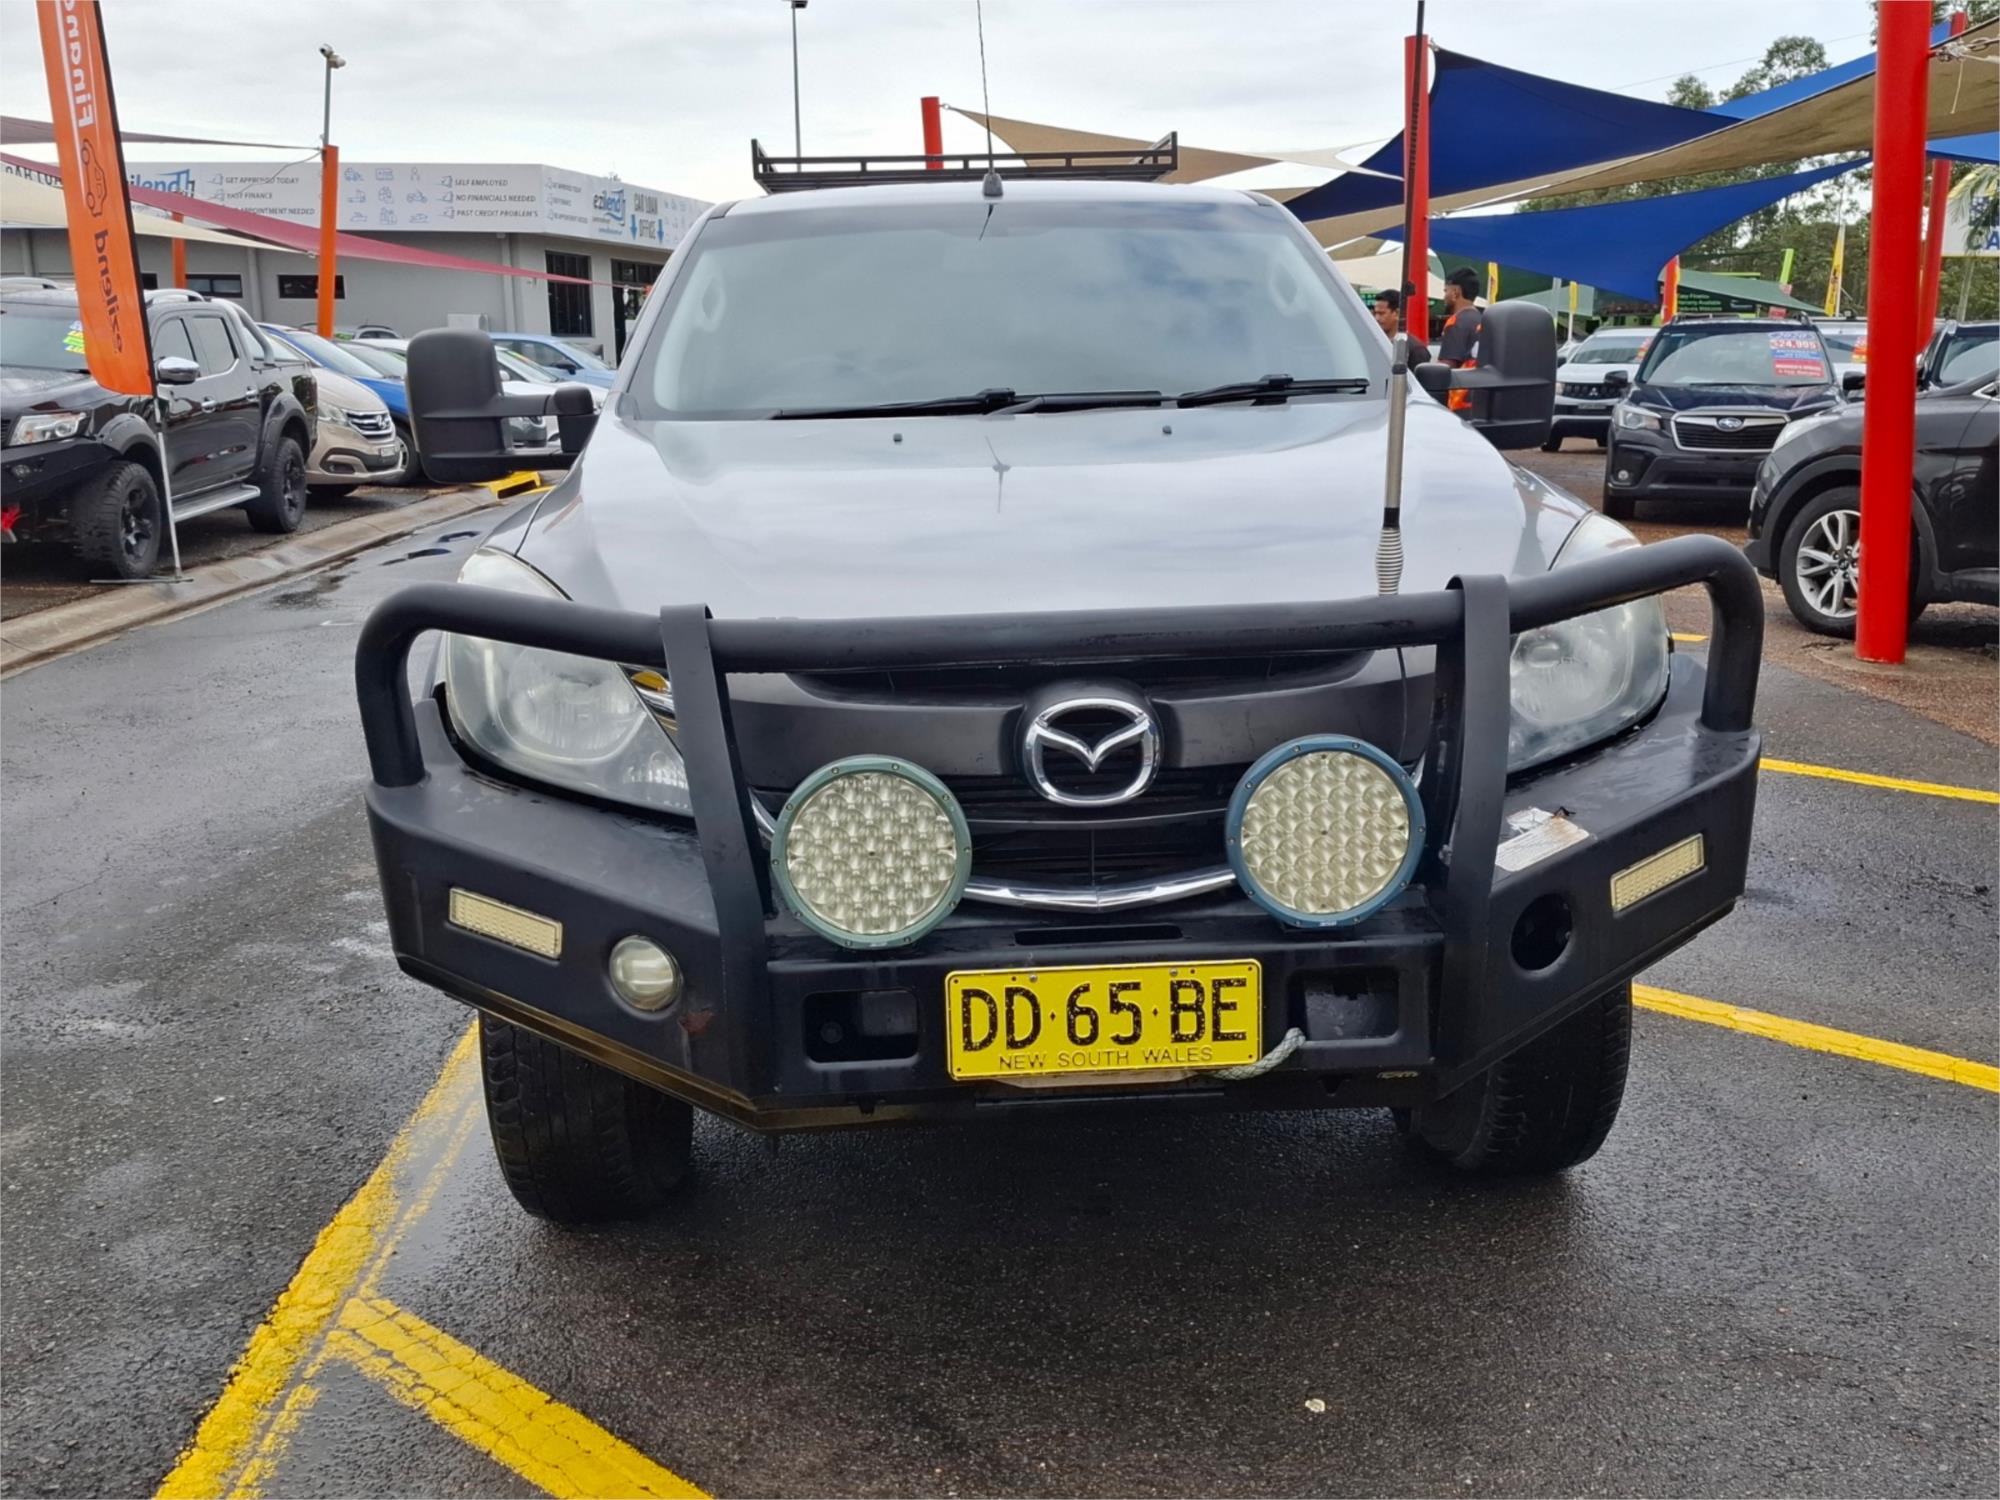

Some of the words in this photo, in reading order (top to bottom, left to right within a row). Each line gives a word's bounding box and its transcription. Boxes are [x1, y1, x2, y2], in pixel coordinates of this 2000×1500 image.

[471, 179, 509, 187] EMPLOYED
[456, 194, 466, 202] NO
[467, 194, 507, 202] FINANCIALS
[288, 207, 315, 215] NEEDED
[457, 209, 473, 217] PAST
[474, 209, 499, 217] CREDIT
[999, 1053, 1047, 1070] NEW
[1058, 1050, 1129, 1068] SOUTH
[1144, 1046, 1213, 1064] WALES
